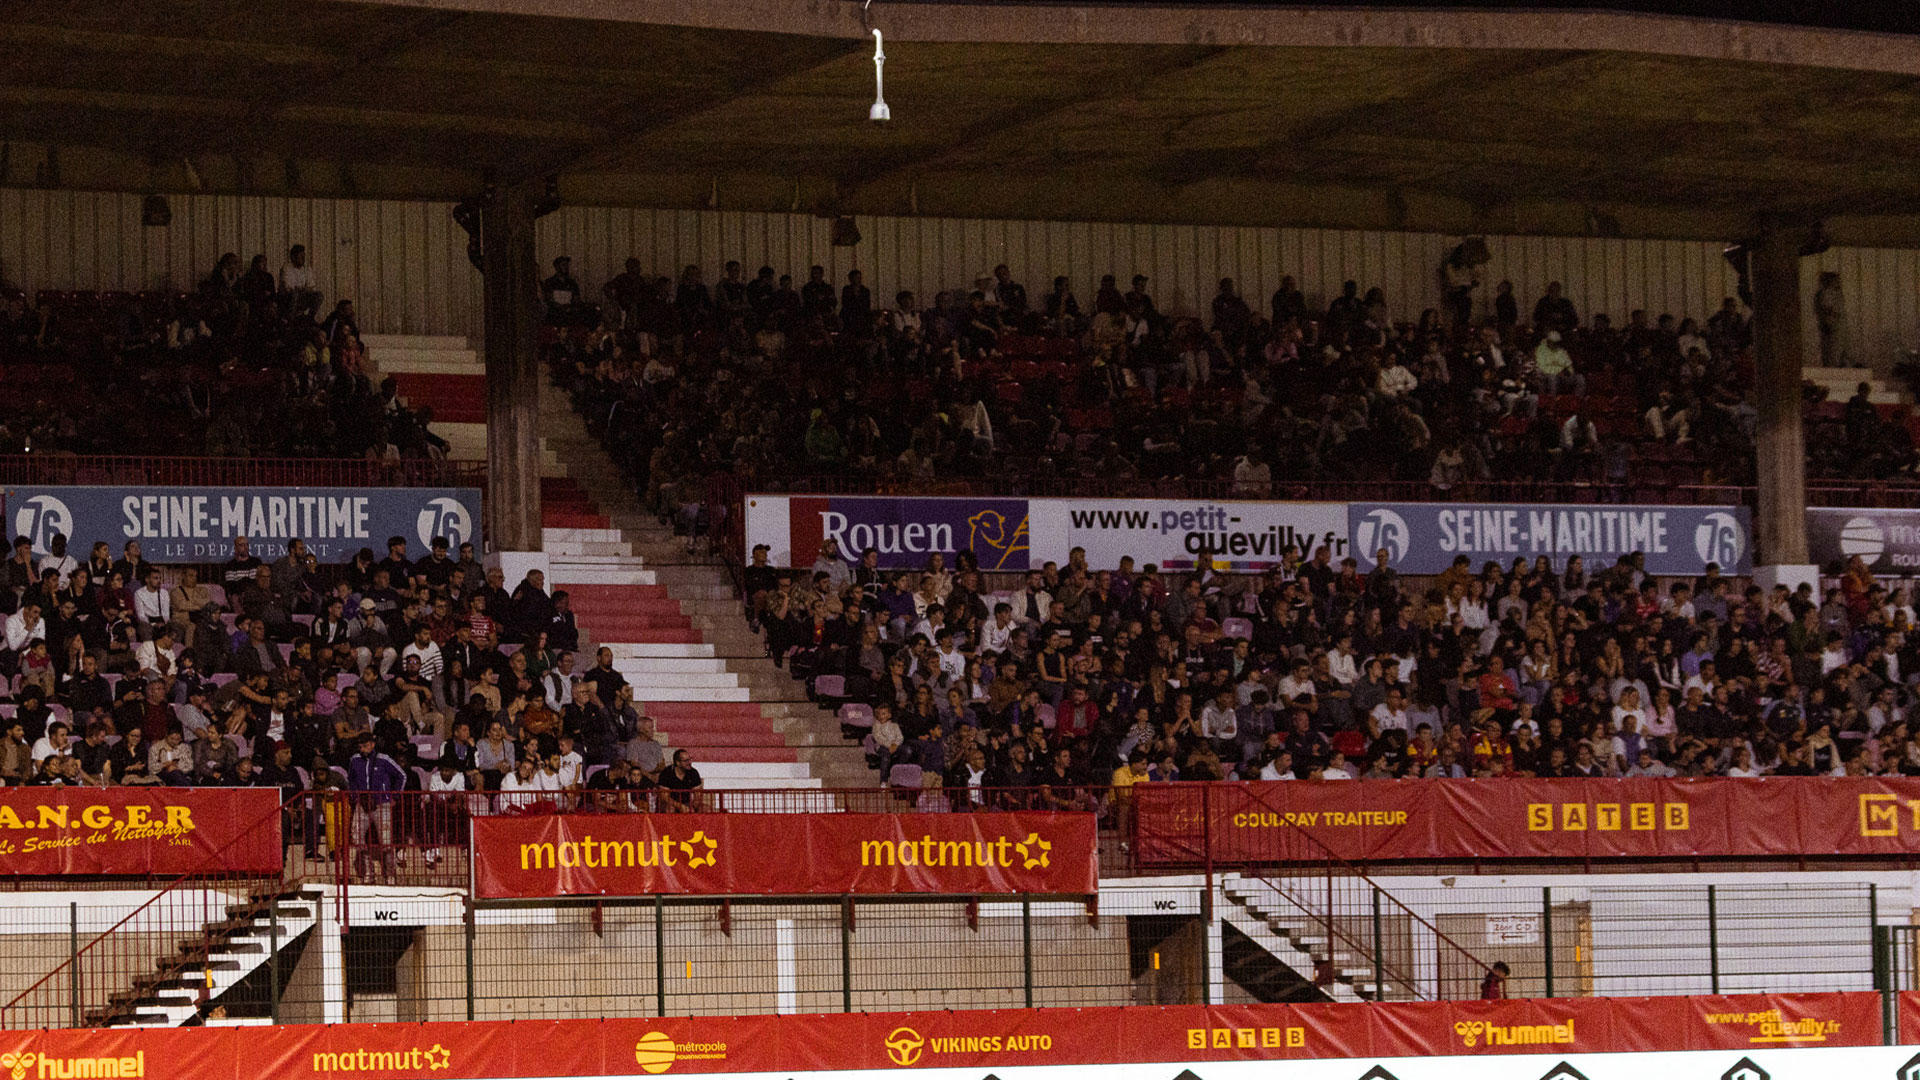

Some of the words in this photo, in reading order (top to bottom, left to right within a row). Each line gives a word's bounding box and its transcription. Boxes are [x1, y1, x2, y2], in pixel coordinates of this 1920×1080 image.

[19, 502, 62, 554] 76
[122, 496, 370, 538] SEINE-MARITIME
[1071, 506, 1241, 534] www.petit-
[424, 504, 461, 558] 76
[818, 511, 957, 562] Rouen
[1363, 515, 1400, 568] 76
[1439, 509, 1668, 553] SEINE-MARITIME
[1702, 519, 1736, 568] 76
[166, 543, 186, 556] LE
[1234, 812, 1319, 827] COUDRAY
[1323, 811, 1407, 825] TRAITEUR
[1531, 805, 1687, 829] SATEB
[22, 836, 81, 853] Service
[87, 831, 107, 844] du
[112, 825, 191, 842] Nettoyage
[520, 834, 677, 869] matmut
[861, 835, 1013, 867] matmut
[375, 911, 398, 920] WC
[1154, 901, 1177, 910] WC
[1705, 1009, 1782, 1025] www.petit
[1760, 1018, 1840, 1037] quevilly.fr
[930, 1036, 1000, 1053] VIKINGS
[1006, 1035, 1052, 1051] AUTO
[1188, 1027, 1304, 1048] SATEB
[1486, 1019, 1574, 1045] hummel
[314, 1047, 422, 1071] matmut
[676, 1042, 726, 1053] métropole
[38, 1050, 144, 1079] hummel
